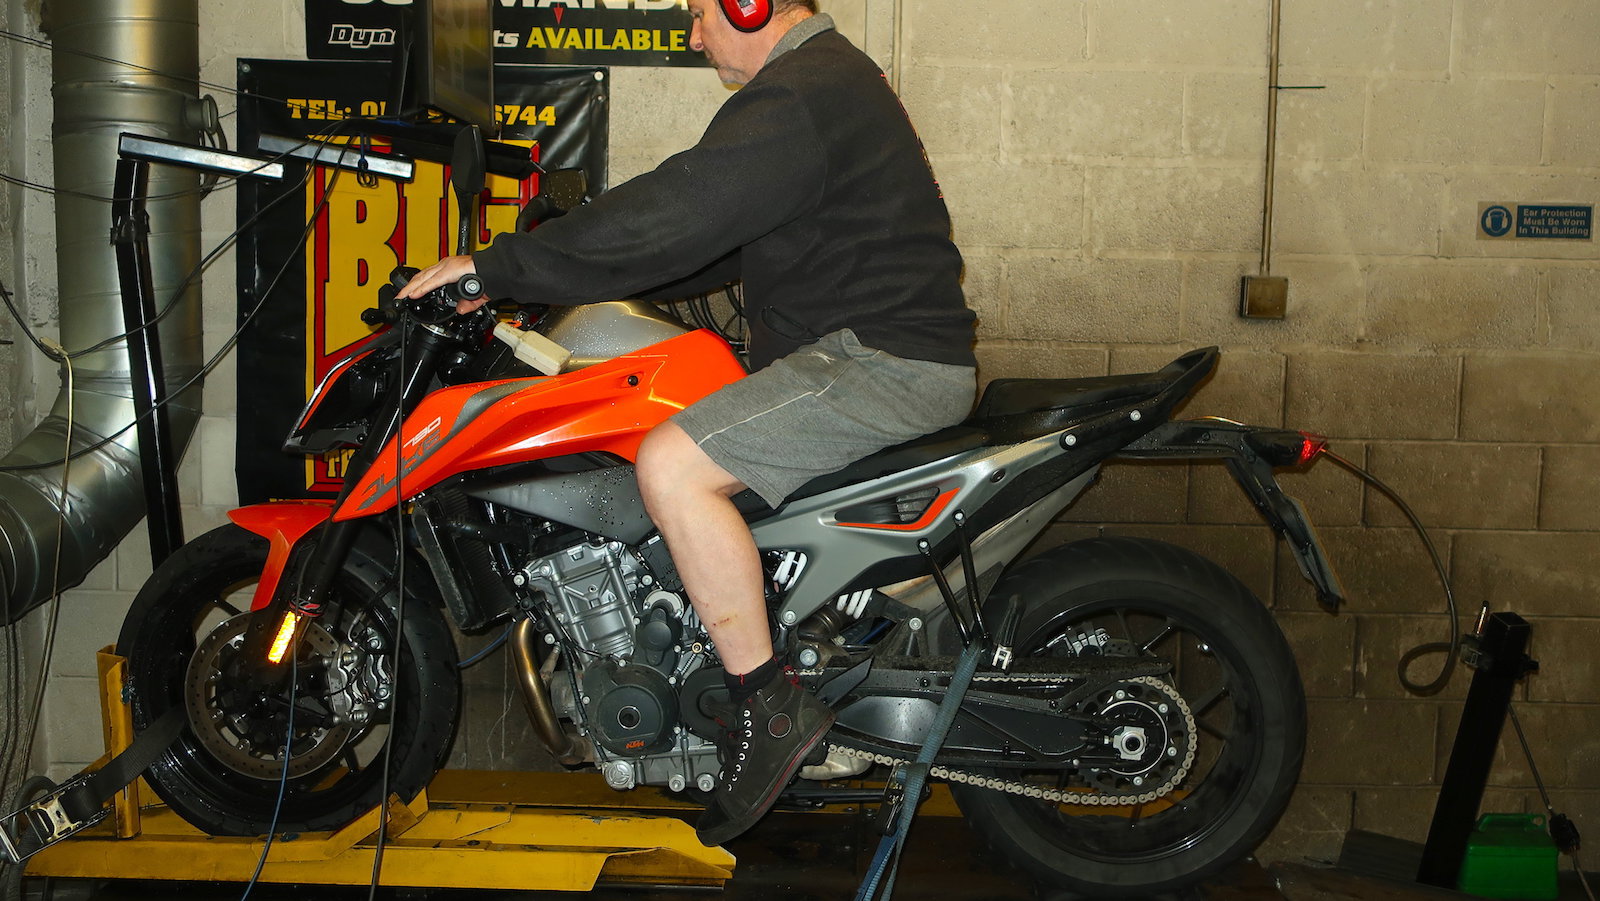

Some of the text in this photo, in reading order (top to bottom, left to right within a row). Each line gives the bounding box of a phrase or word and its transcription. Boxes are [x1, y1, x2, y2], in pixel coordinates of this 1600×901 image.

[328, 24, 396, 49] Dyn
[526, 27, 686, 51] AVAILABLE
[287, 99, 350, 120] TEL:
[1523, 208, 1587, 218] Ear Protection
[1523, 217, 1586, 226] Must Be Worn
[1519, 226, 1589, 236] In This Building
[403, 416, 441, 448] 790
